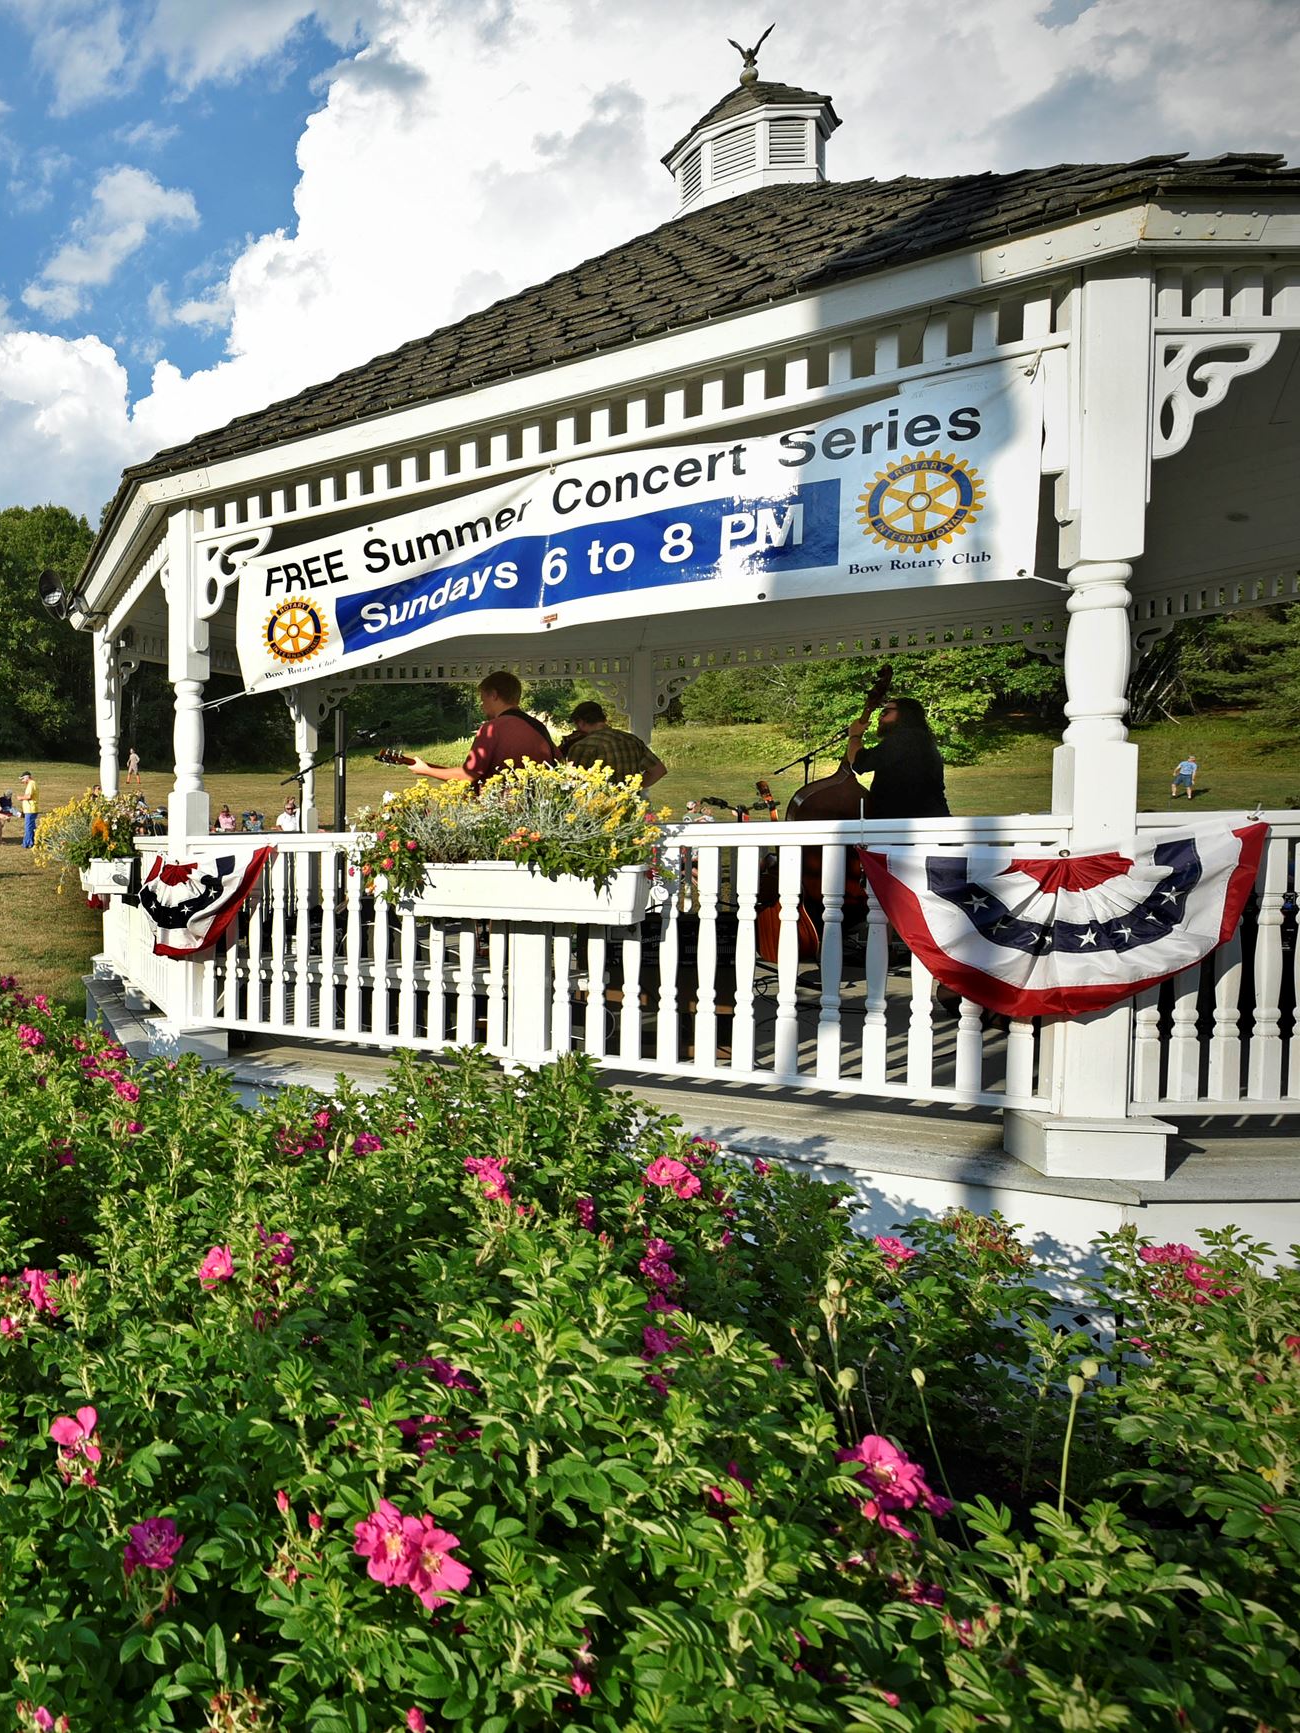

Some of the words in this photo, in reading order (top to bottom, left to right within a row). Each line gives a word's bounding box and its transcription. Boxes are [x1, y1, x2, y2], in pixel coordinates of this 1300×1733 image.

[894, 462, 950, 479] ROTARY
[265, 549, 349, 597] FREE
[363, 498, 533, 574] Summer
[553, 444, 747, 515] Concert
[778, 406, 981, 467] Series
[876, 513, 965, 543] INTERNATIONAL
[360, 561, 518, 634] Sundays
[541, 547, 568, 586] 6
[587, 540, 635, 575] to
[659, 522, 694, 564] 8
[720, 503, 805, 555] PM
[849, 563, 883, 575] Bow
[890, 557, 946, 571] Rotary
[952, 551, 992, 565] Club
[279, 602, 306, 614] ROTARY
[264, 670, 284, 680] Bow
